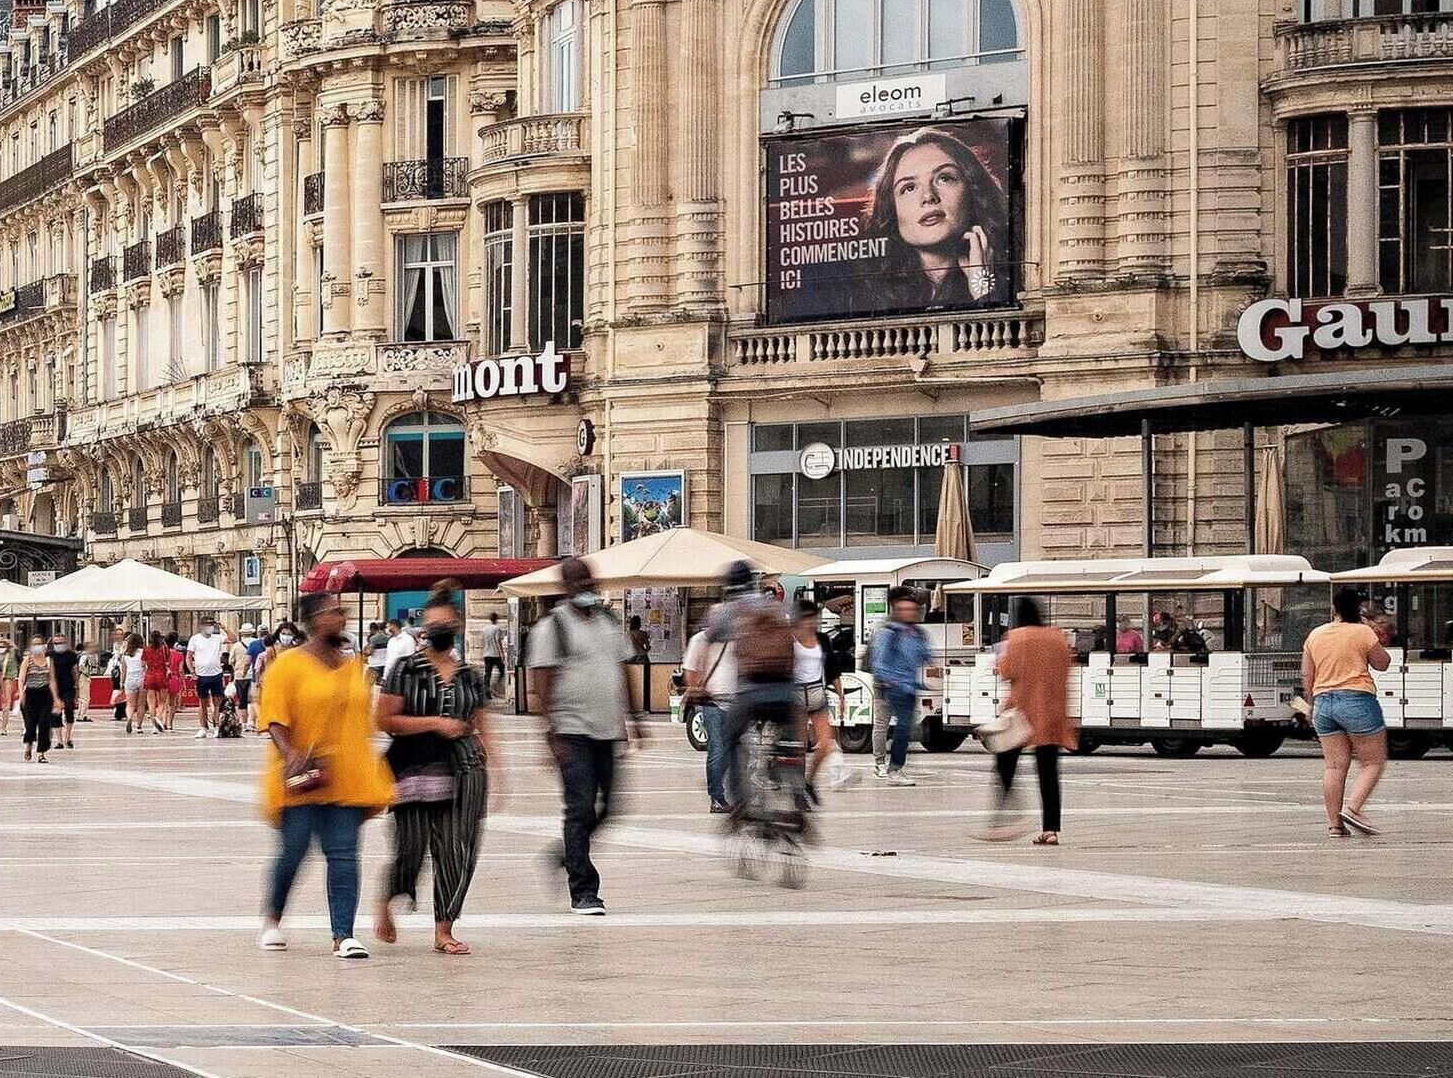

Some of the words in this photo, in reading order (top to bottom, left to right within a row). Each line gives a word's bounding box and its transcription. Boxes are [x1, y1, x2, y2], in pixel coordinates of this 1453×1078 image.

[859, 84, 922, 104] eleom
[859, 101, 922, 114] avocats
[779, 153, 806, 173] LES
[779, 175, 818, 198] PLUS
[779, 197, 835, 221] BELLES
[779, 217, 859, 244] HISTOIRES
[779, 237, 889, 267] COMMENCENT
[780, 269, 802, 290] ICI
[1237, 297, 1453, 362] Gau
[833, 444, 950, 471] INDEPENDENCE
[388, 477, 457, 502] CIC
